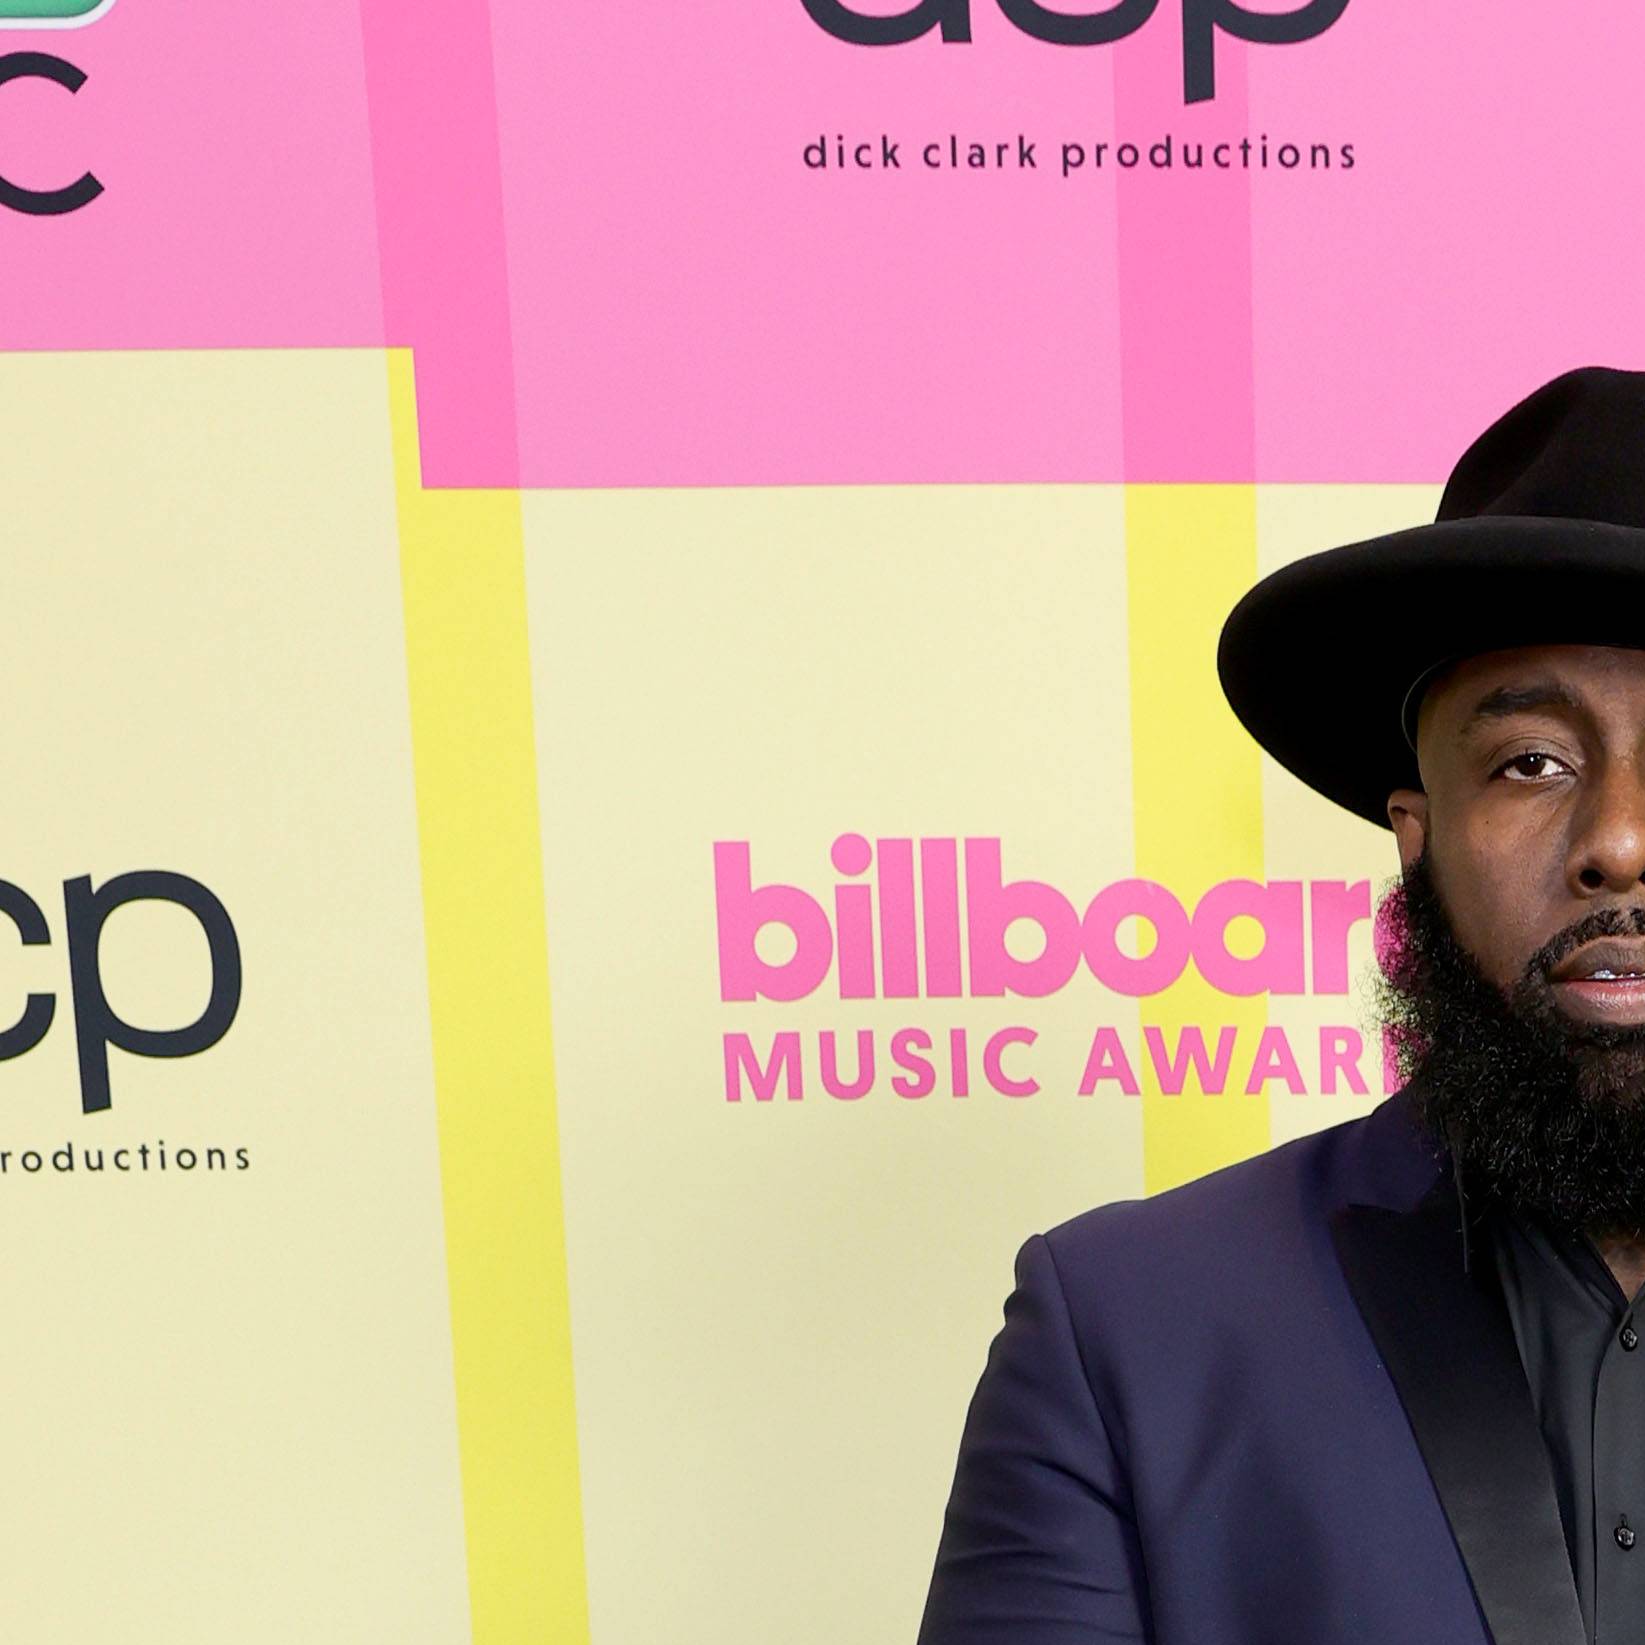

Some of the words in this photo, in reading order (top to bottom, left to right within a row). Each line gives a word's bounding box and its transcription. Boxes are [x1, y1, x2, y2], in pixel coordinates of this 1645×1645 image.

[805, 136, 900, 169] dick
[924, 136, 1037, 169] clark
[1063, 136, 1355, 178] productions
[725, 1028, 1041, 1102] MUSIC
